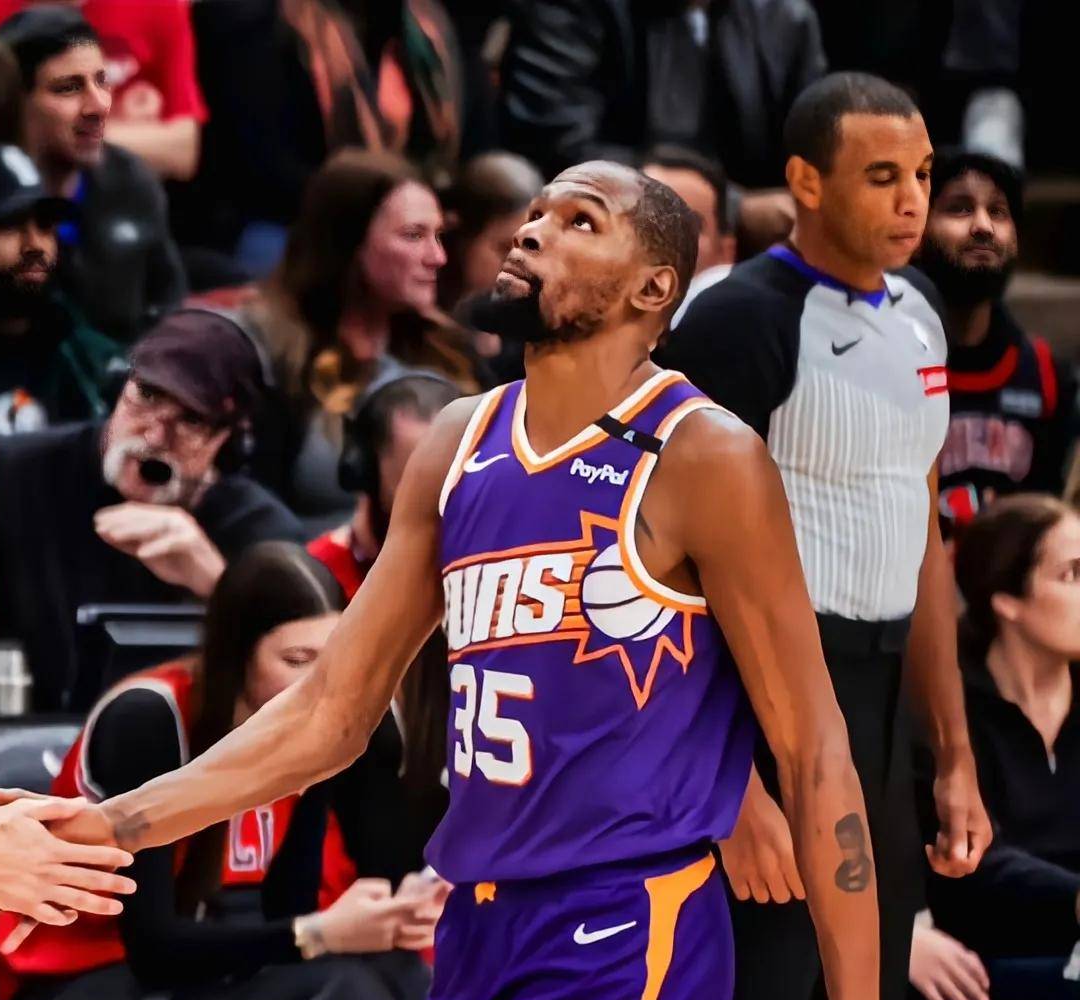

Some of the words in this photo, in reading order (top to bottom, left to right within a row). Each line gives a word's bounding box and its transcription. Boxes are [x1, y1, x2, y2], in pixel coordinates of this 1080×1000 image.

[569, 457, 630, 486] PayPal
[443, 552, 574, 652] UNS
[449, 663, 535, 790] 35
